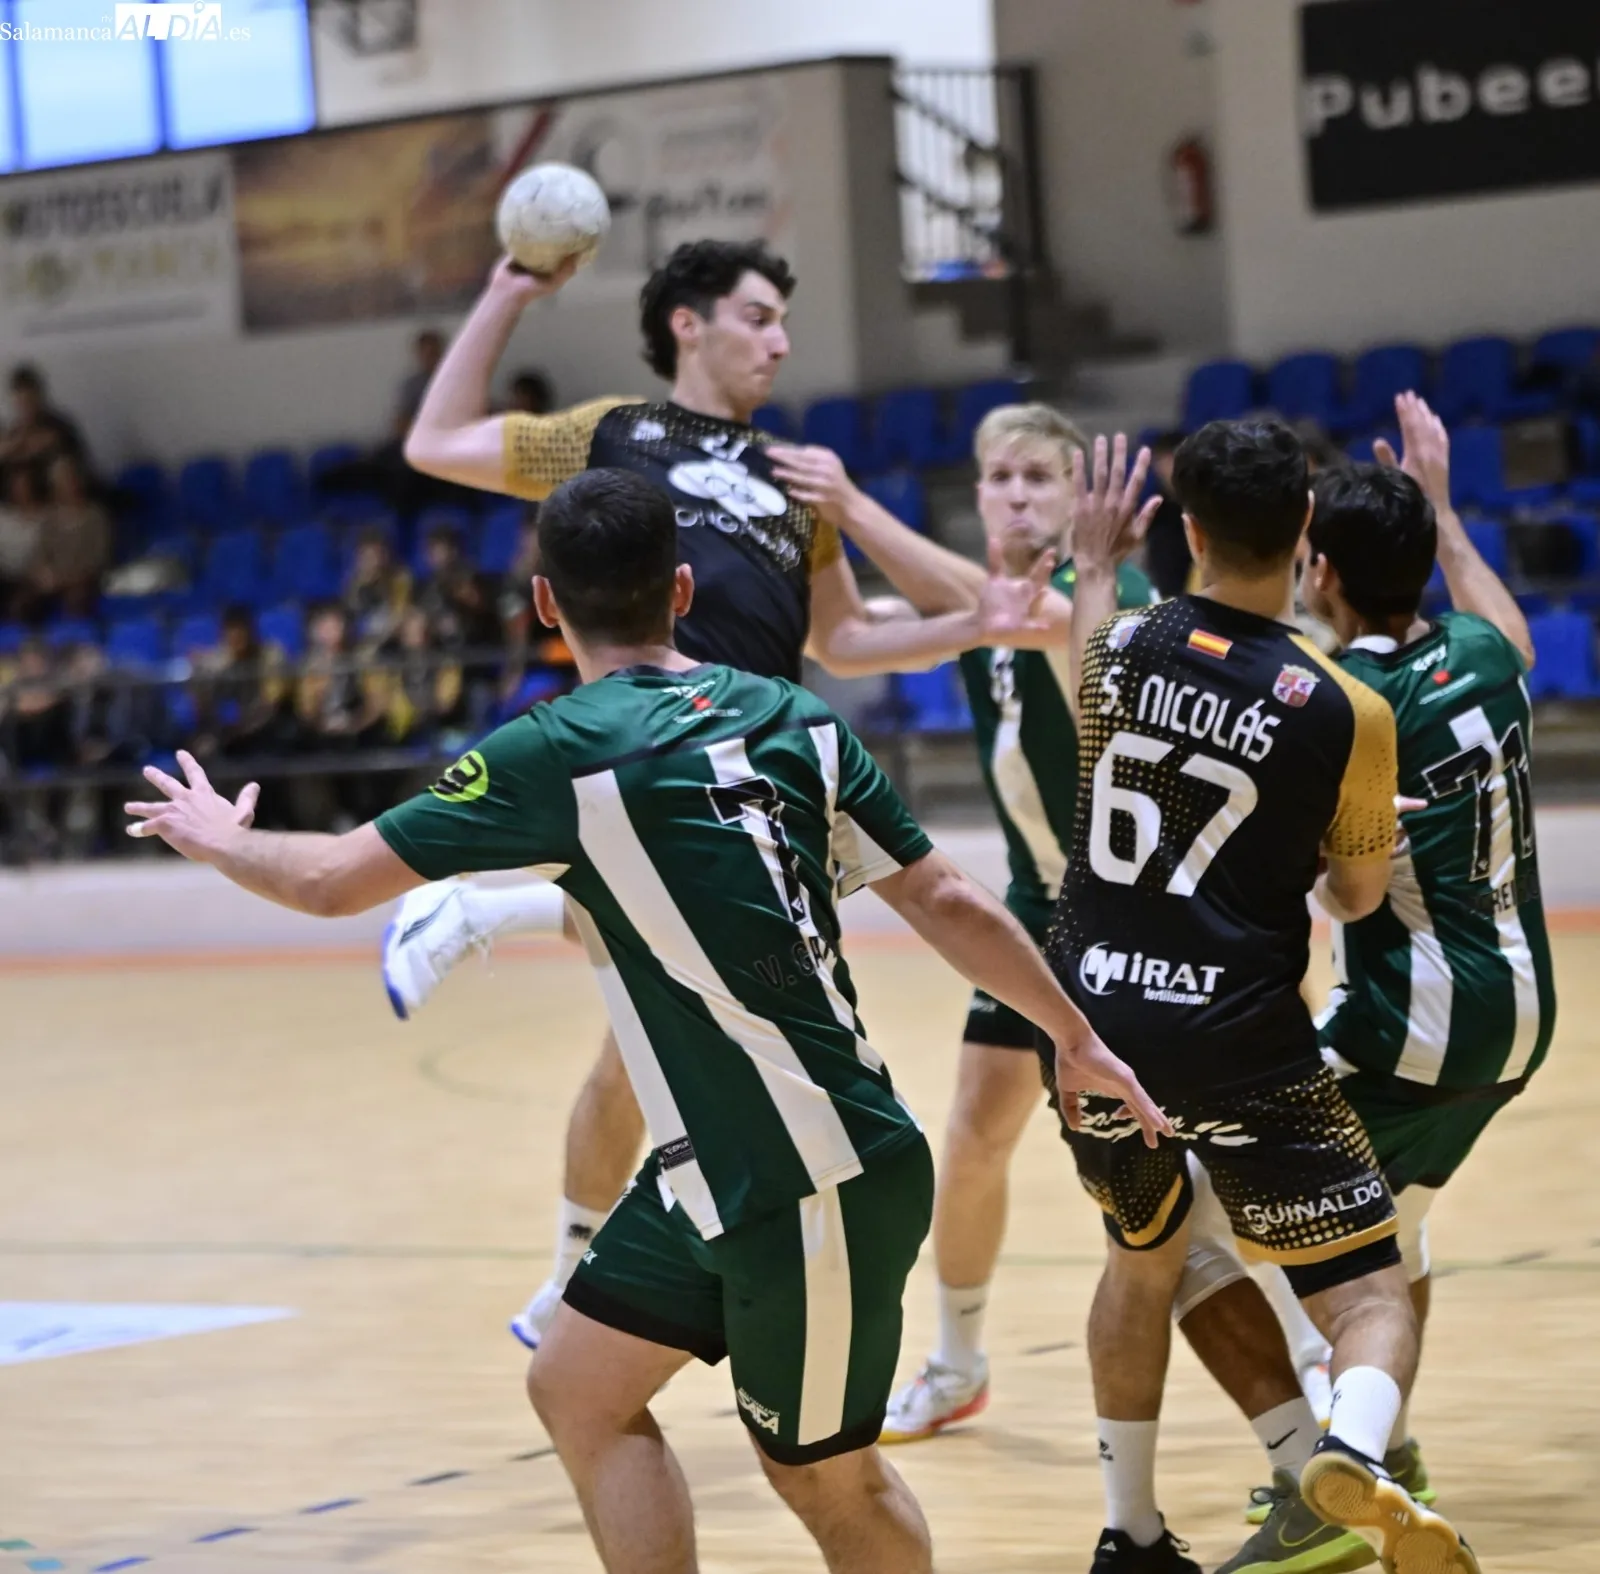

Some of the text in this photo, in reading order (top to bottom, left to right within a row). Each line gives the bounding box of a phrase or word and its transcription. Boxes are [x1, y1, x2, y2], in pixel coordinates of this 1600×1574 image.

[1300, 56, 1600, 138] Pubee
[1136, 673, 1282, 763] NICOLÁS
[1088, 729, 1259, 898] 67
[1242, 1179, 1383, 1235] GUINALDO
